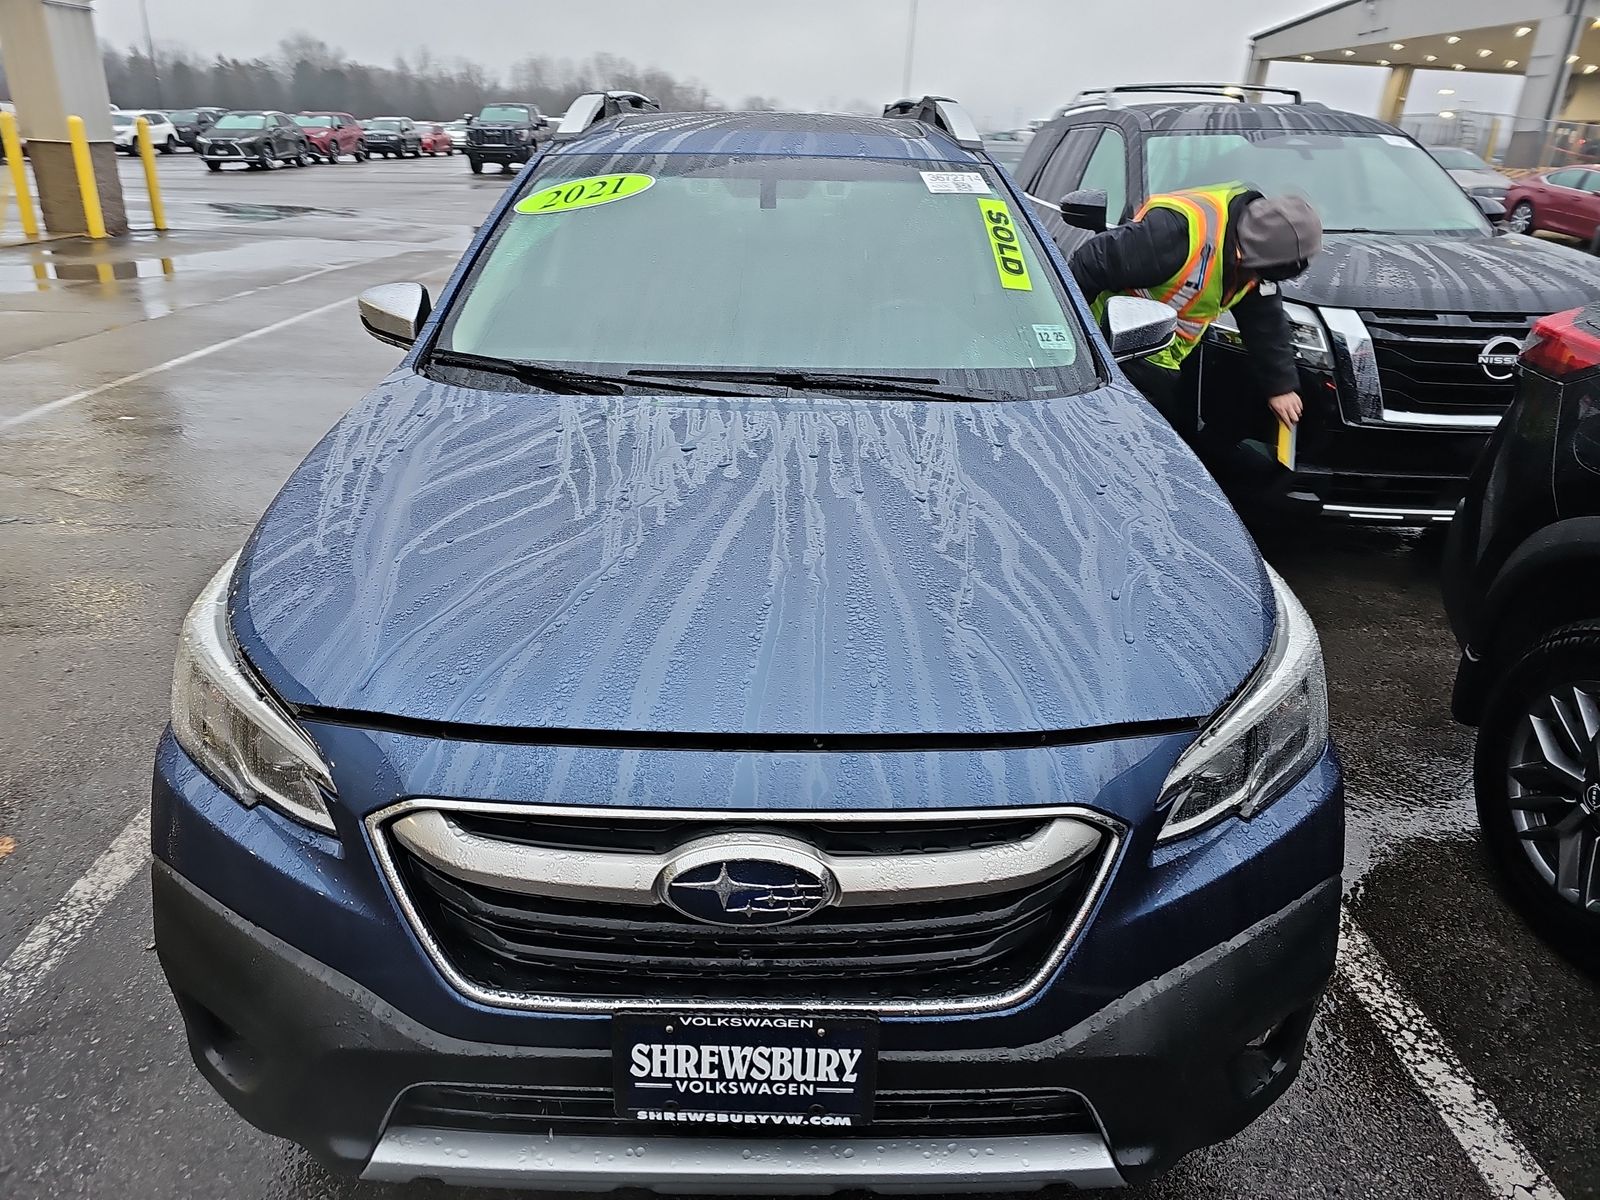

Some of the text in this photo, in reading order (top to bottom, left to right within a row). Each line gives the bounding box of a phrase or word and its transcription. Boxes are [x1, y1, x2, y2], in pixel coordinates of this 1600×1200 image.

[538, 177, 627, 209] 2021
[986, 209, 1024, 275] SOLD
[1039, 332, 1066, 342] 12 25
[679, 1016, 814, 1029] VOLKSWAGEN
[629, 1043, 862, 1083] SHREWSBURY
[675, 1080, 814, 1096] VOLKSWAGEN
[636, 1110, 852, 1126] SHREWSBURYVW.COM
